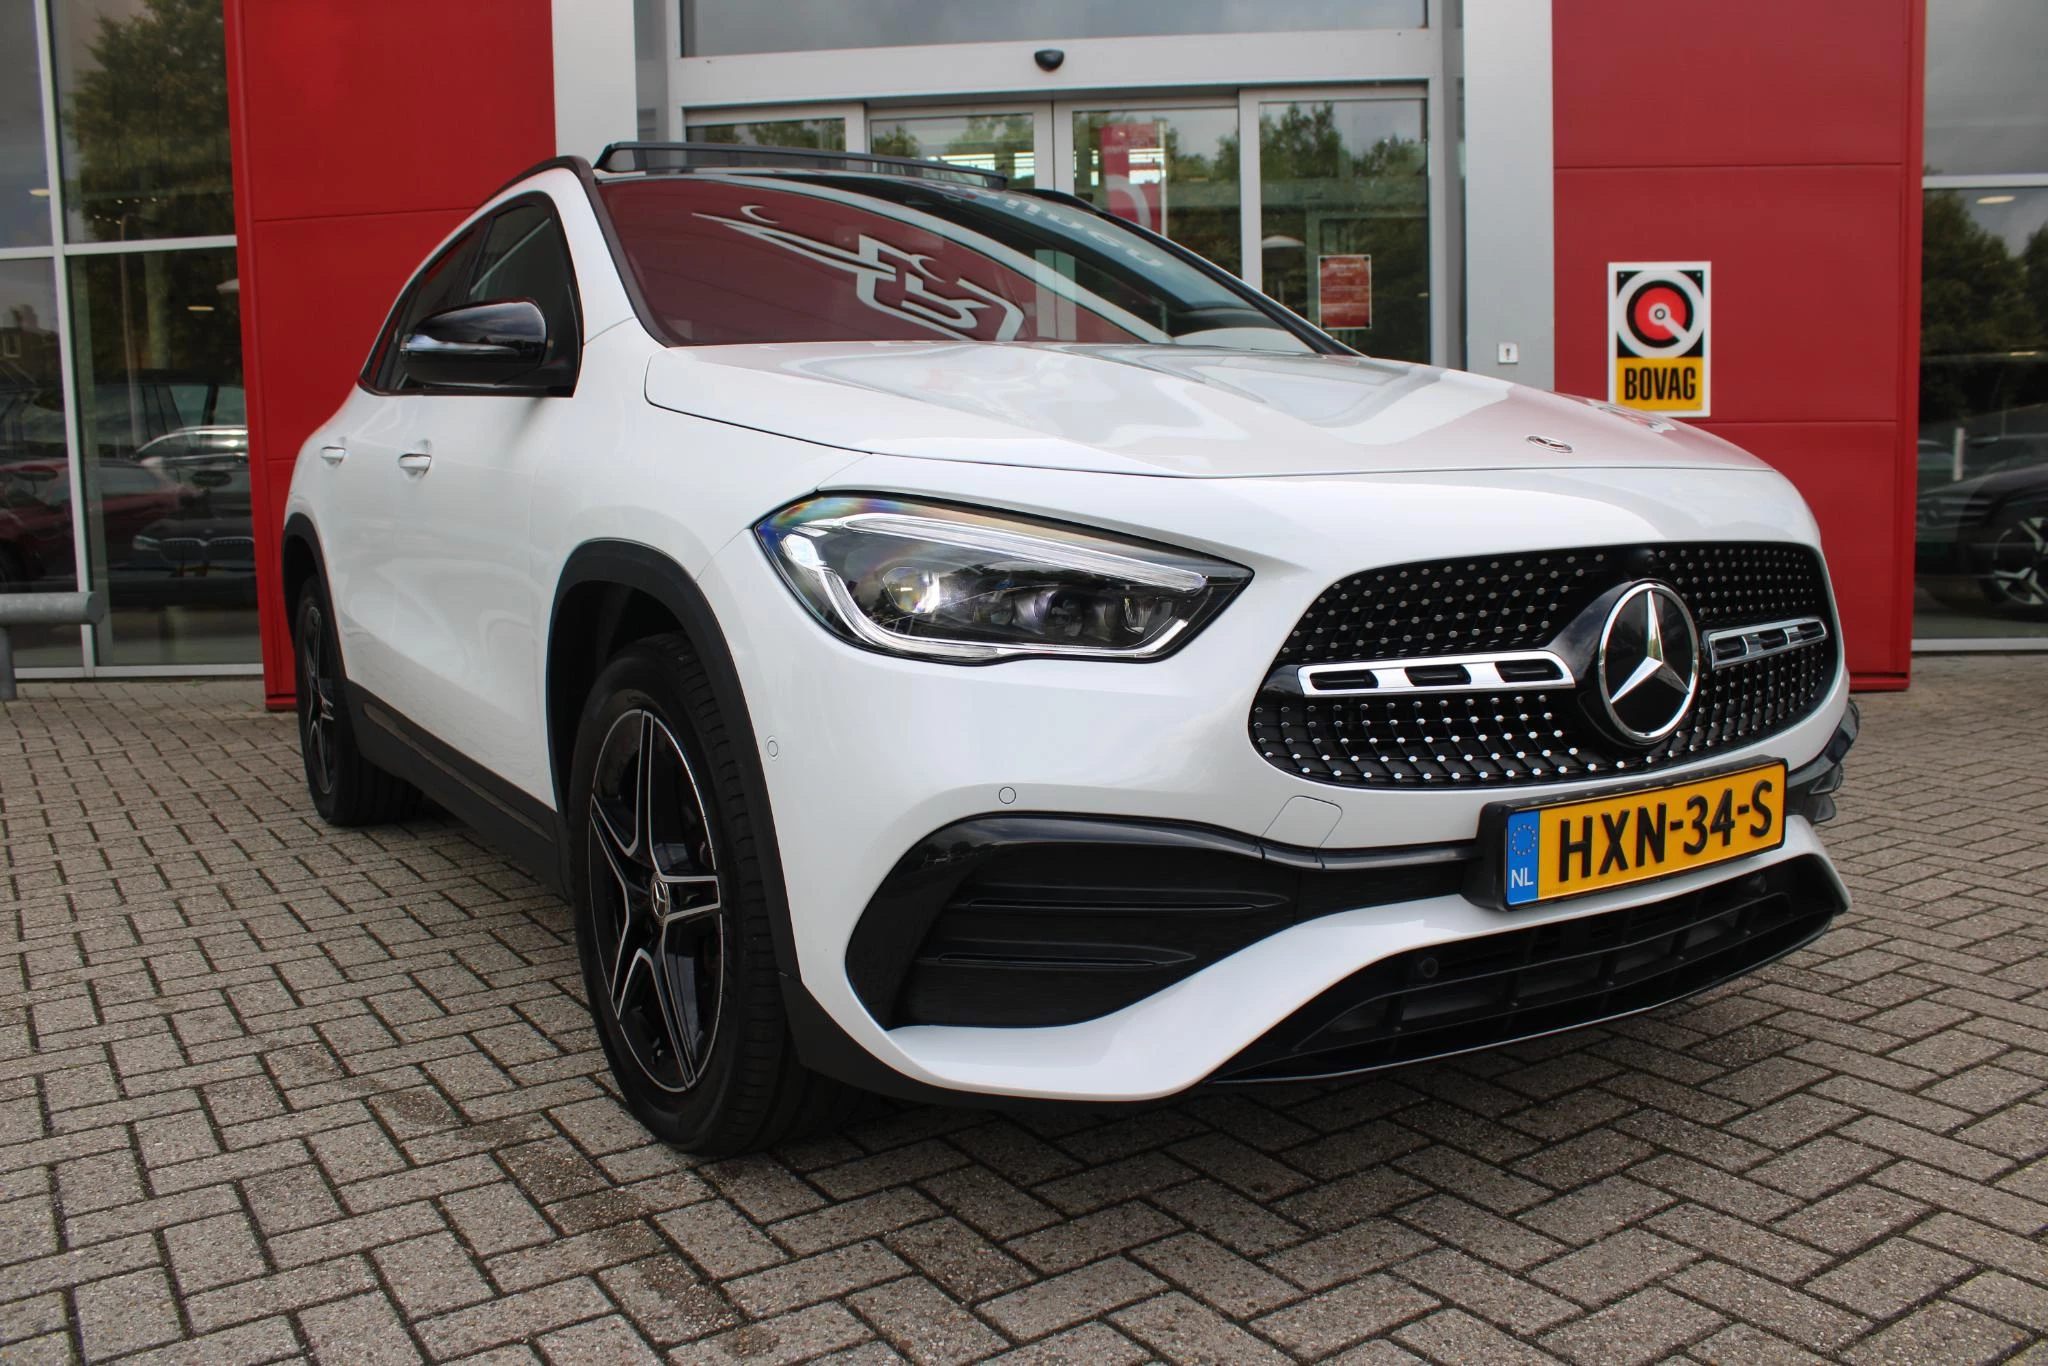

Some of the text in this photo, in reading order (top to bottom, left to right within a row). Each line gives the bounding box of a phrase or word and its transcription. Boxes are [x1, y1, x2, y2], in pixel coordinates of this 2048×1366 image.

[1624, 366, 1696, 401] BOVAG
[1558, 779, 1773, 883] HXN-34-S
[1510, 866, 1535, 889] NL
